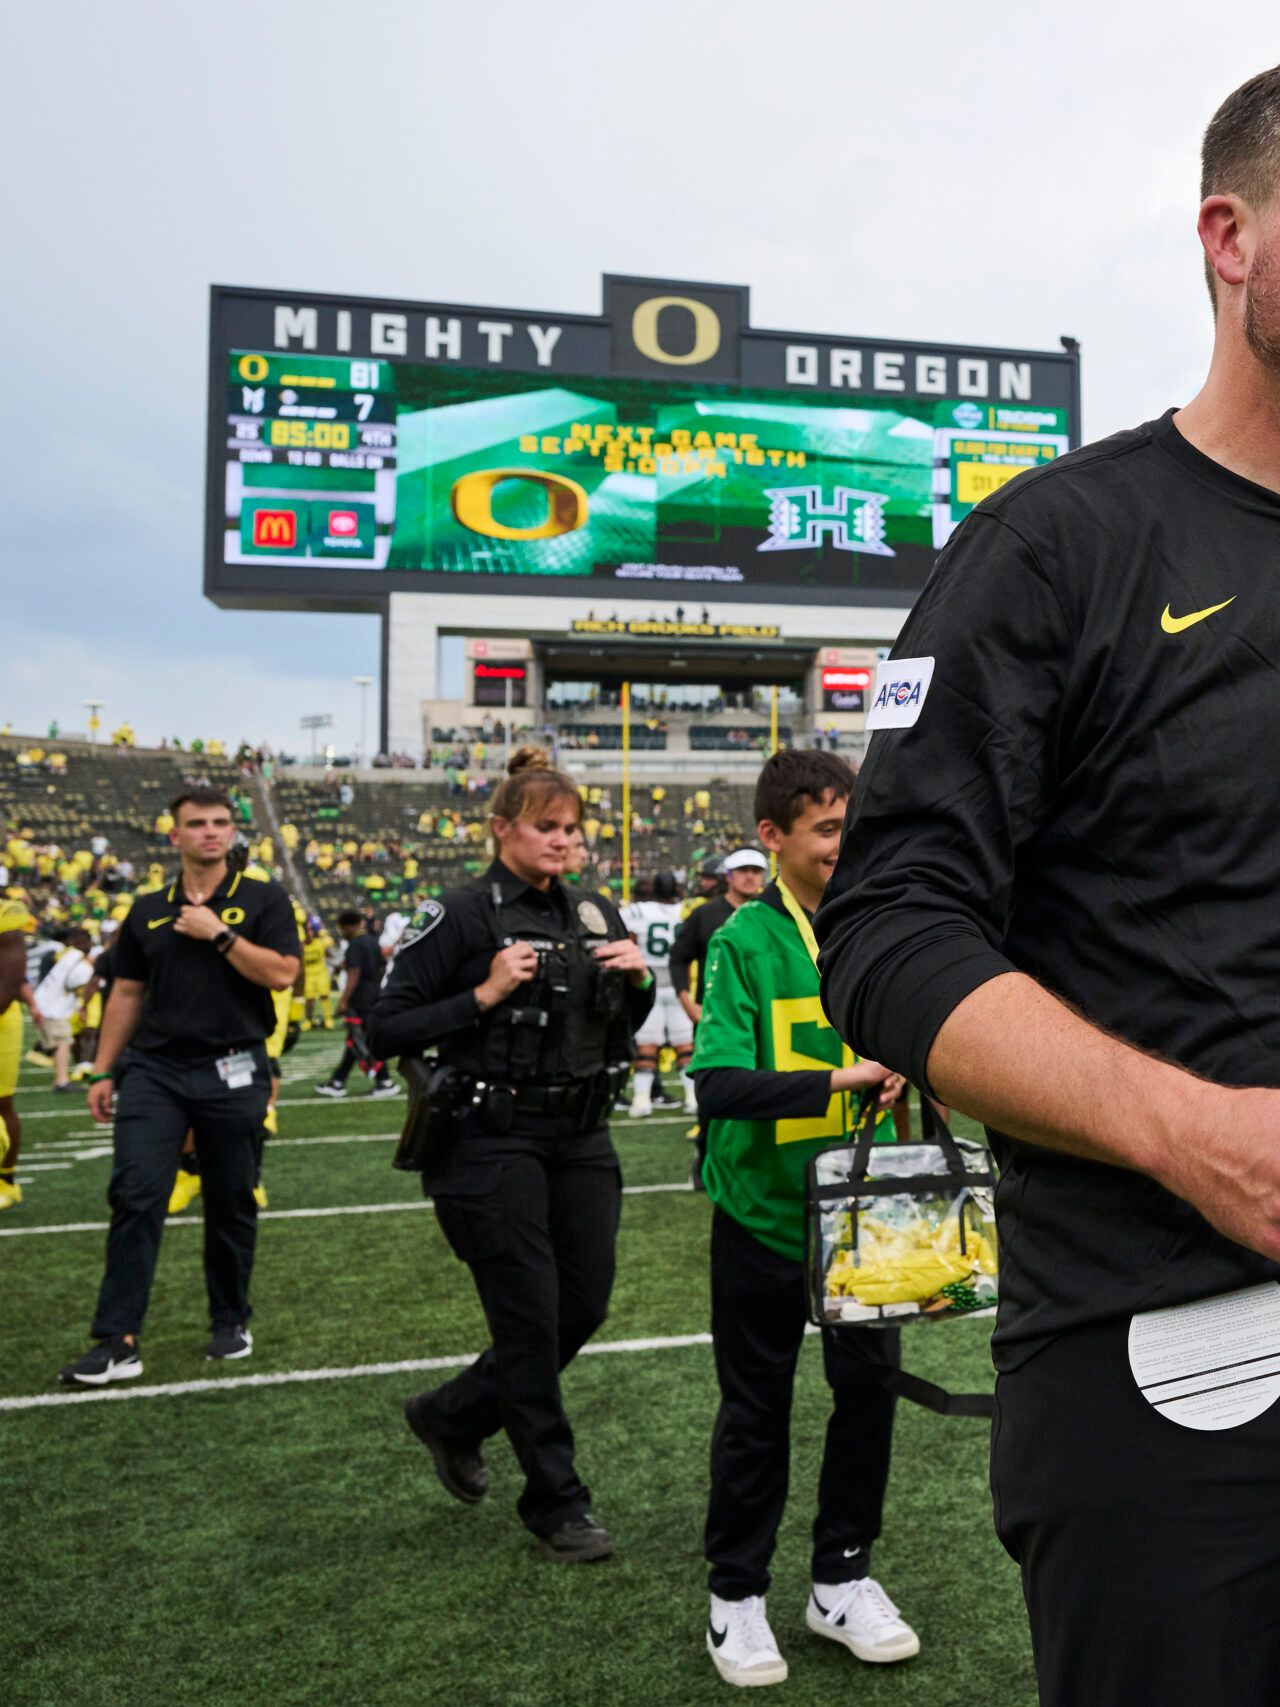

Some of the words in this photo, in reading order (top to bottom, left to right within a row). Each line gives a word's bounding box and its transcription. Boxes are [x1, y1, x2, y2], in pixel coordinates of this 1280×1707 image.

[632, 296, 721, 366] O
[274, 305, 562, 367] MIGHTY
[786, 345, 1032, 400] OREGON
[350, 361, 380, 390] 81
[353, 393, 375, 421] 7
[570, 423, 655, 442] NEXT
[671, 429, 758, 450] GAME
[719, 625, 779, 638] FIELD
[874, 680, 921, 708] AFCA
[221, 906, 246, 926] O
